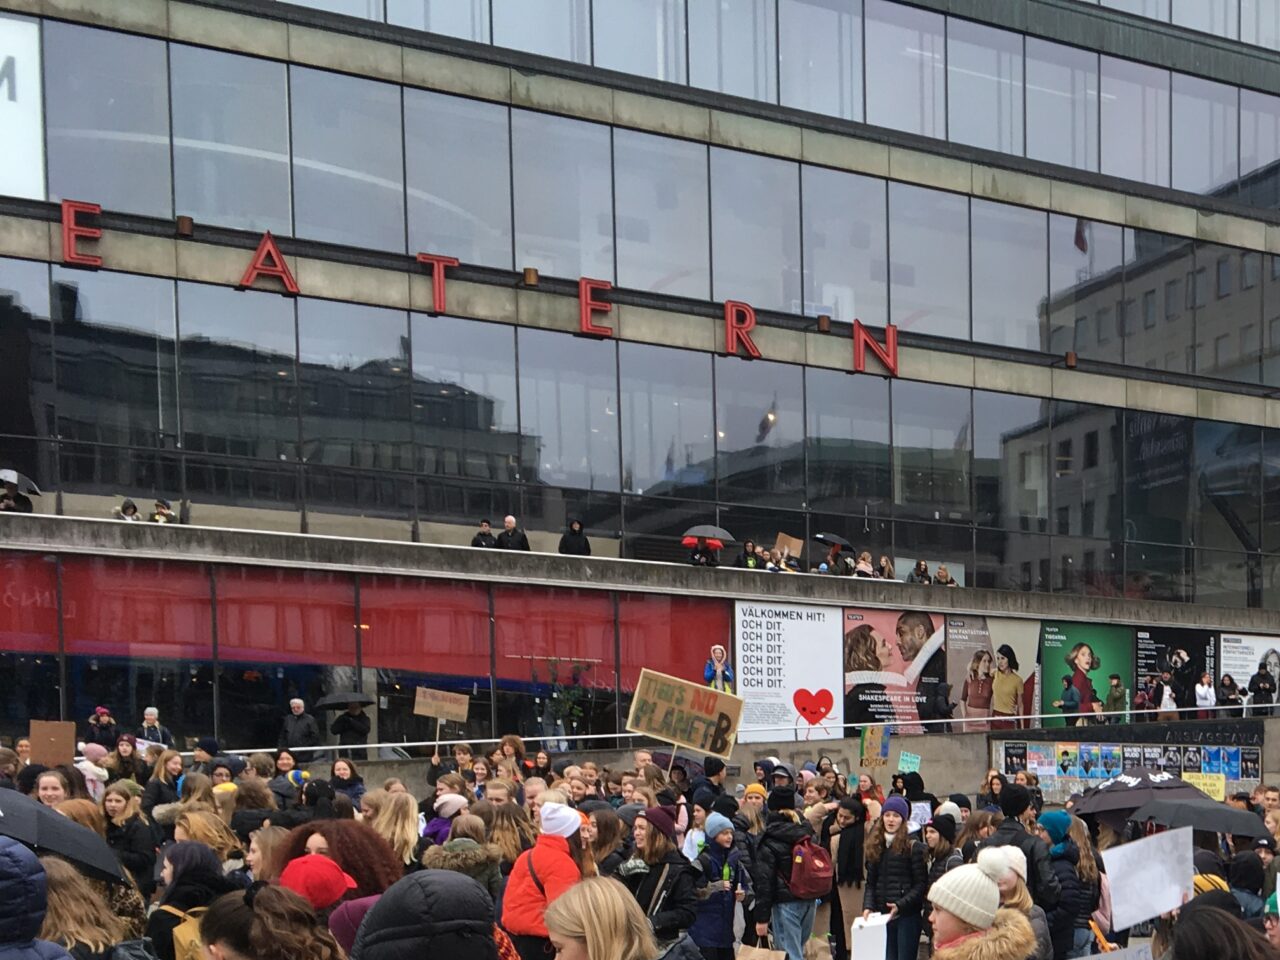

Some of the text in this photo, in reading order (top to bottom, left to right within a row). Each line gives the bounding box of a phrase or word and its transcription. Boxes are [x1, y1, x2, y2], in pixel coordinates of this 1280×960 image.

[741, 605, 826, 622] VÄLKOMMEN HIT!
[742, 620, 785, 631] OCH DIT.
[742, 631, 785, 642] OCH DIT.
[742, 643, 785, 654] OCH DIT.
[743, 654, 786, 666] OCH DIT.
[743, 666, 786, 677] OCH DIT.
[743, 678, 786, 689] OCH DIT.
[690, 688, 718, 716] NO
[858, 694, 902, 702] SHAKESPEARE
[634, 698, 716, 749] PLANET
[709, 712, 732, 754] B
